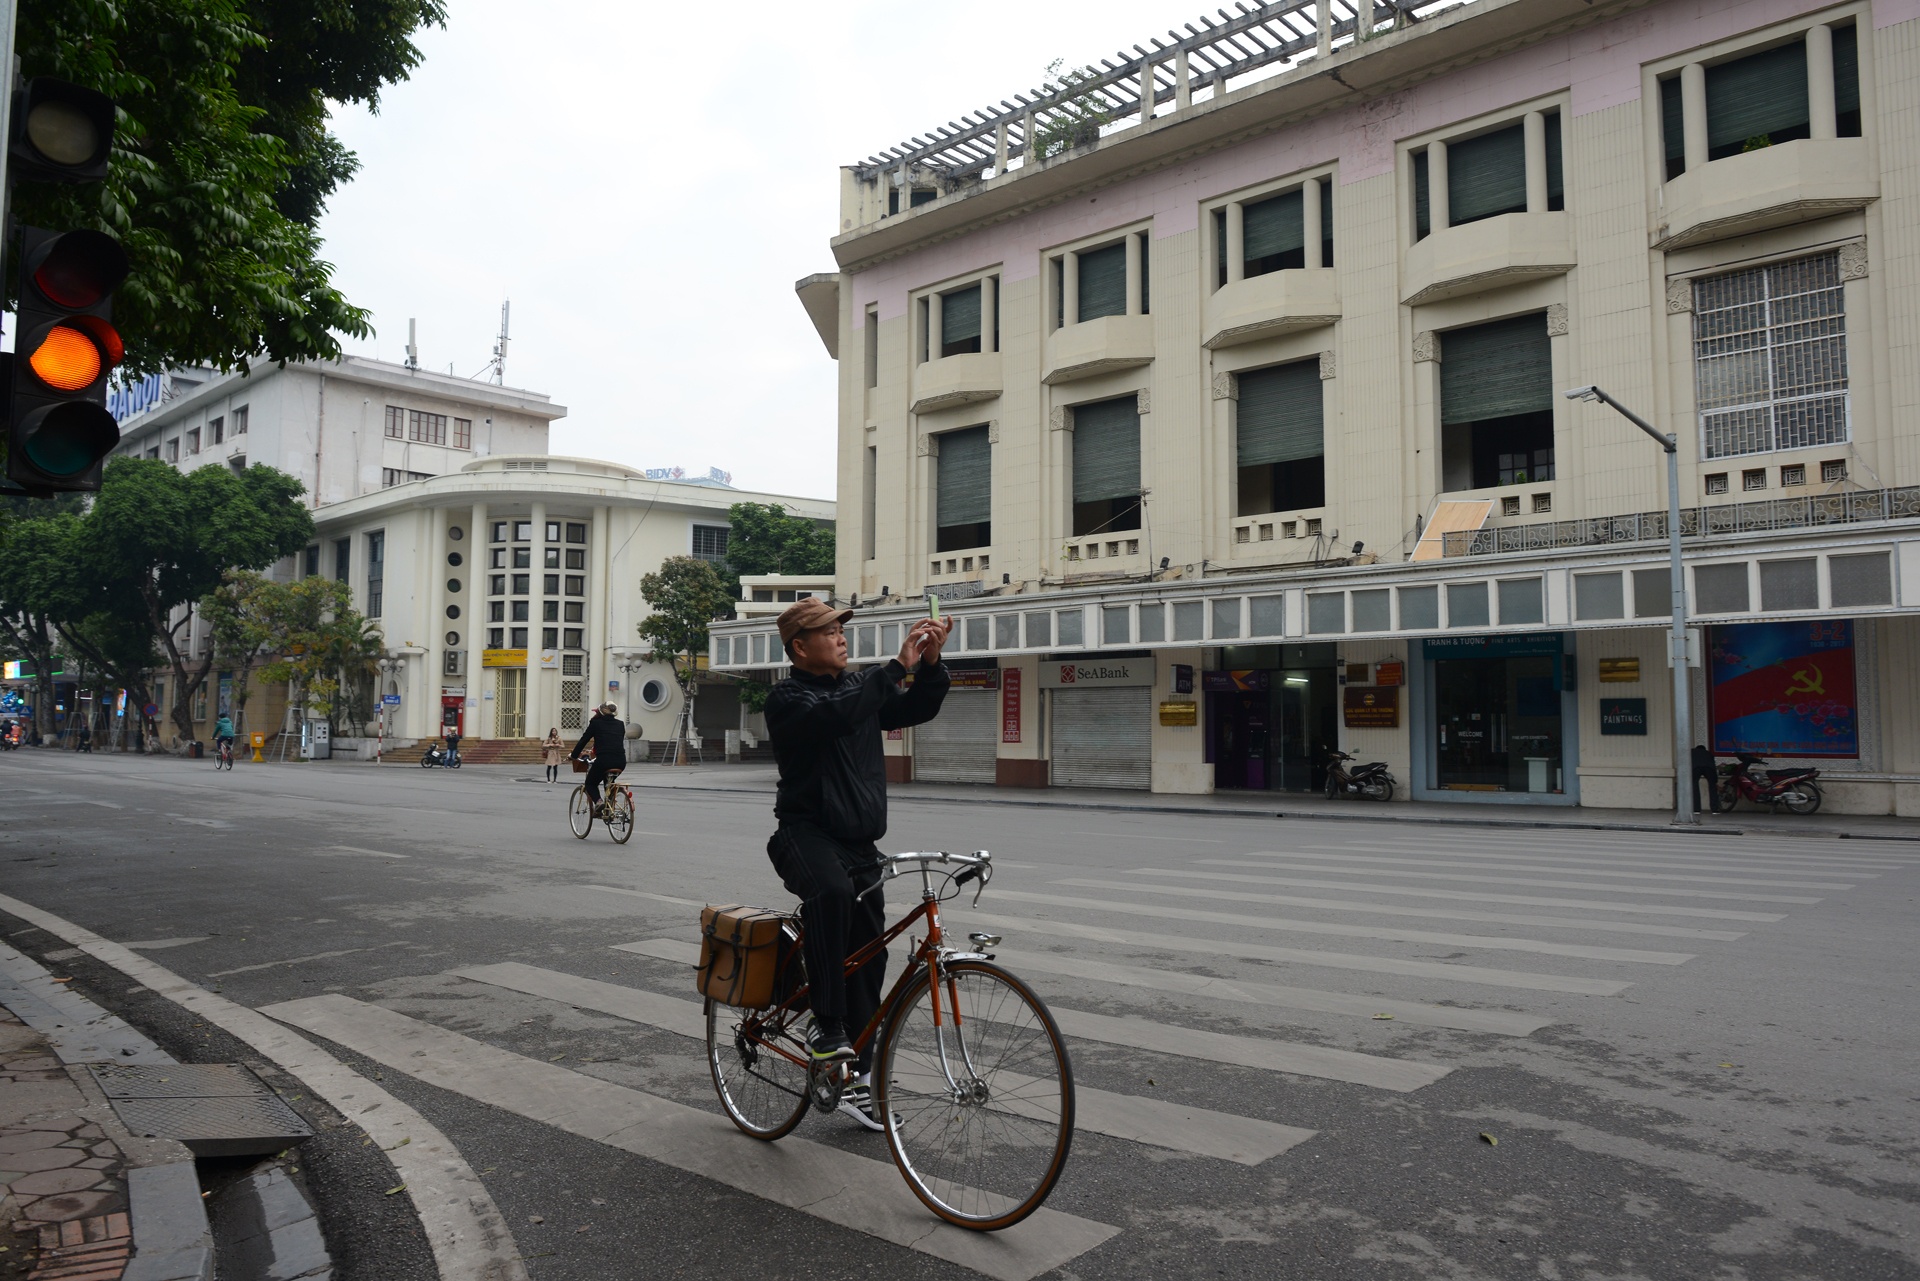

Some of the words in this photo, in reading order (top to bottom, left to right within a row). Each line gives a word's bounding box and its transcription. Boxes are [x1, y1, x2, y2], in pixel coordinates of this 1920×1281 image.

[646, 468, 672, 480] BIDV
[1810, 620, 1845, 640] 3-2
[1078, 666, 1129, 682] SeABank
[1178, 680, 1191, 690] ATM
[1604, 715, 1642, 724] PAINTINGS
